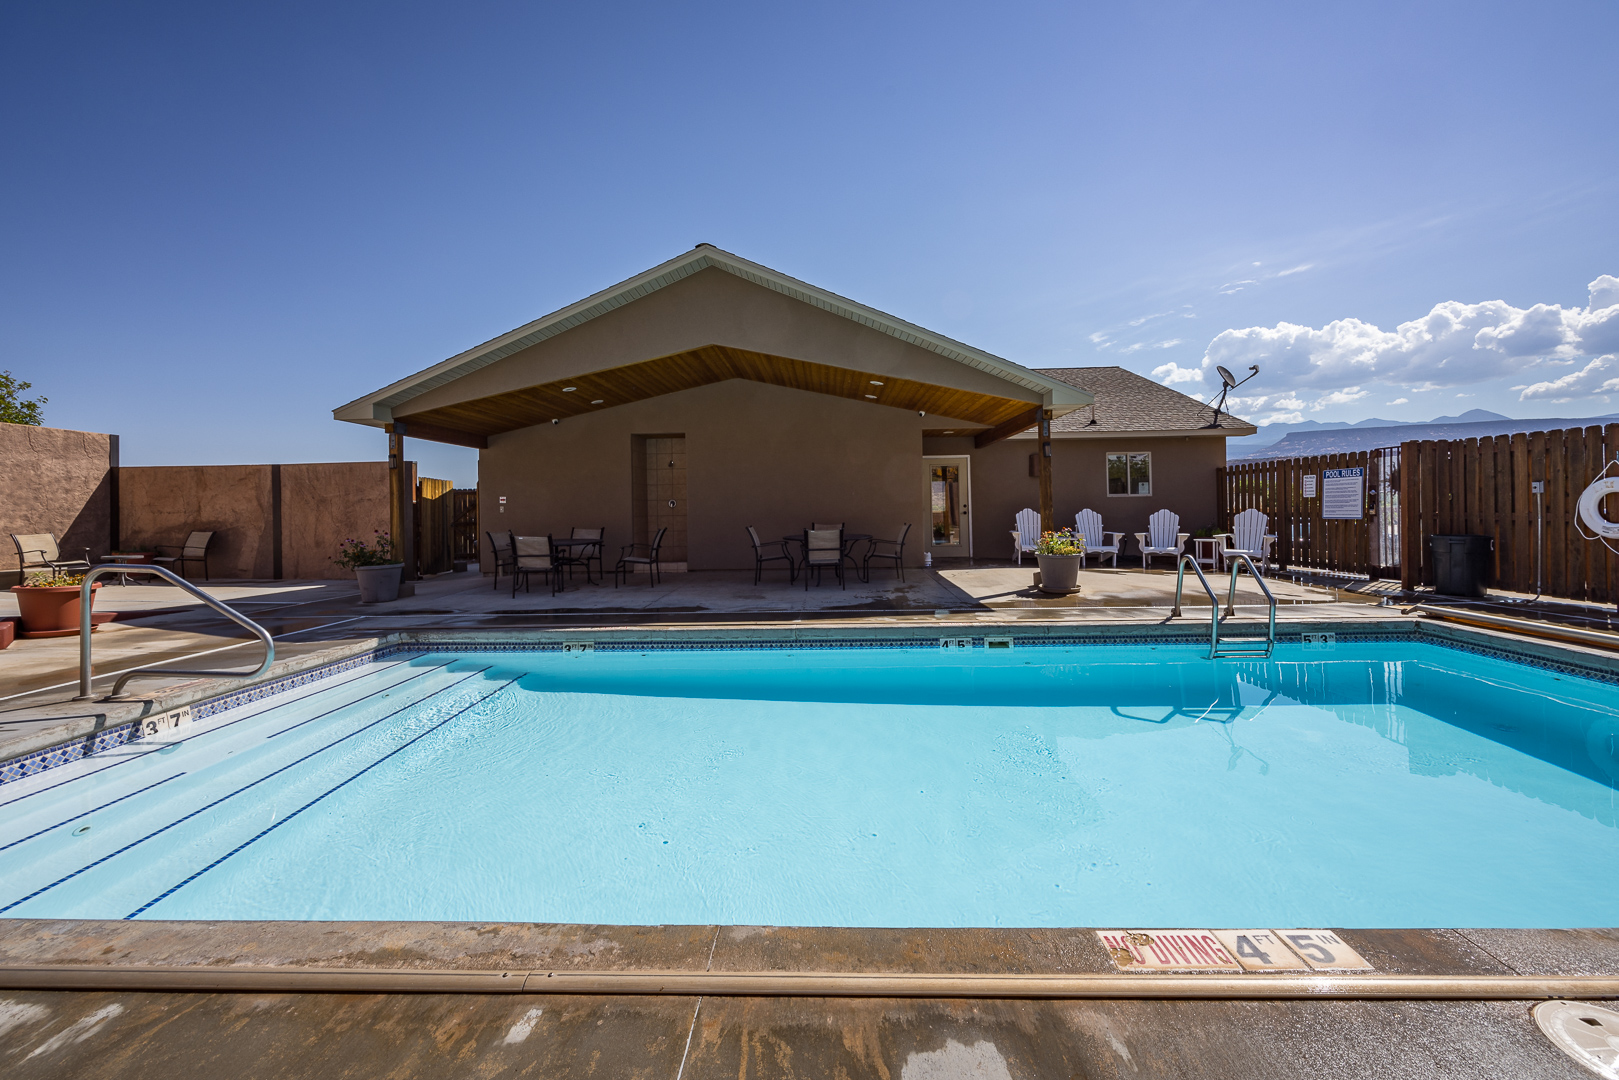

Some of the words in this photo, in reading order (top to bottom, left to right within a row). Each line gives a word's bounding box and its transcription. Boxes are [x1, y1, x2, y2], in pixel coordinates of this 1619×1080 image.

[1325, 470, 1341, 478] POOL
[1341, 468, 1361, 477] RULES
[957, 640, 965, 648] 5
[1303, 635, 1311, 643] 5
[1320, 634, 1328, 643] 3
[580, 644, 587, 652] 7
[146, 720, 158, 735] 3
[157, 716, 165, 725] FT
[169, 712, 180, 727] 7
[181, 709, 190, 718] IN
[1252, 934, 1275, 945] FT
[1315, 934, 1341, 945] IN
[1147, 935, 1234, 965] DIVING
[1236, 935, 1273, 964] 4
[1285, 934, 1336, 964] 5
